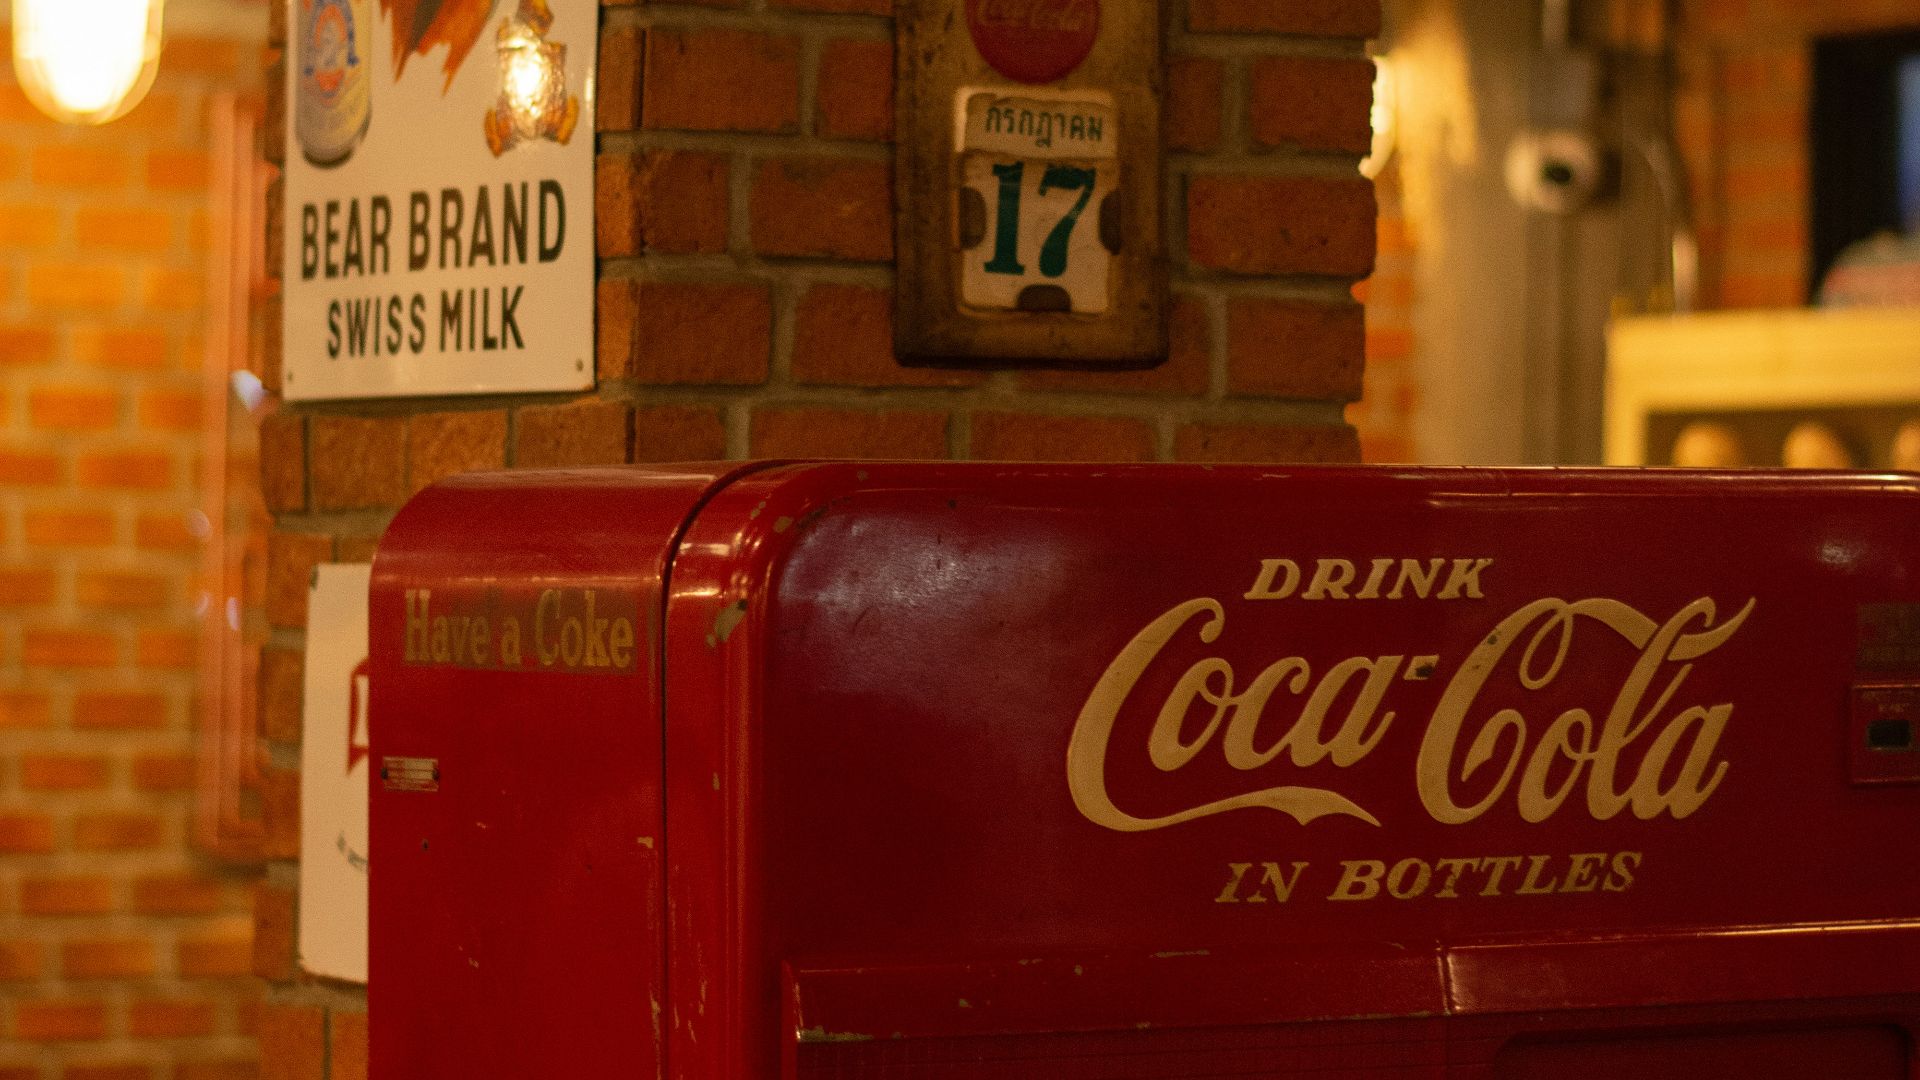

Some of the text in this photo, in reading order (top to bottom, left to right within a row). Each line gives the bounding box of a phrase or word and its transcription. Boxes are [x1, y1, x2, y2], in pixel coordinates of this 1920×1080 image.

[984, 105, 1103, 148] กรกฎาคม
[301, 179, 566, 281] BEAR BRAND
[984, 161, 1097, 279] 17
[327, 284, 525, 360] SWISS MILK
[1243, 558, 1494, 600] DRINK
[404, 588, 635, 669] Have a Coke
[1067, 597, 1756, 832] Coca-Cola
[1214, 851, 1643, 902] IN BOTTLES
